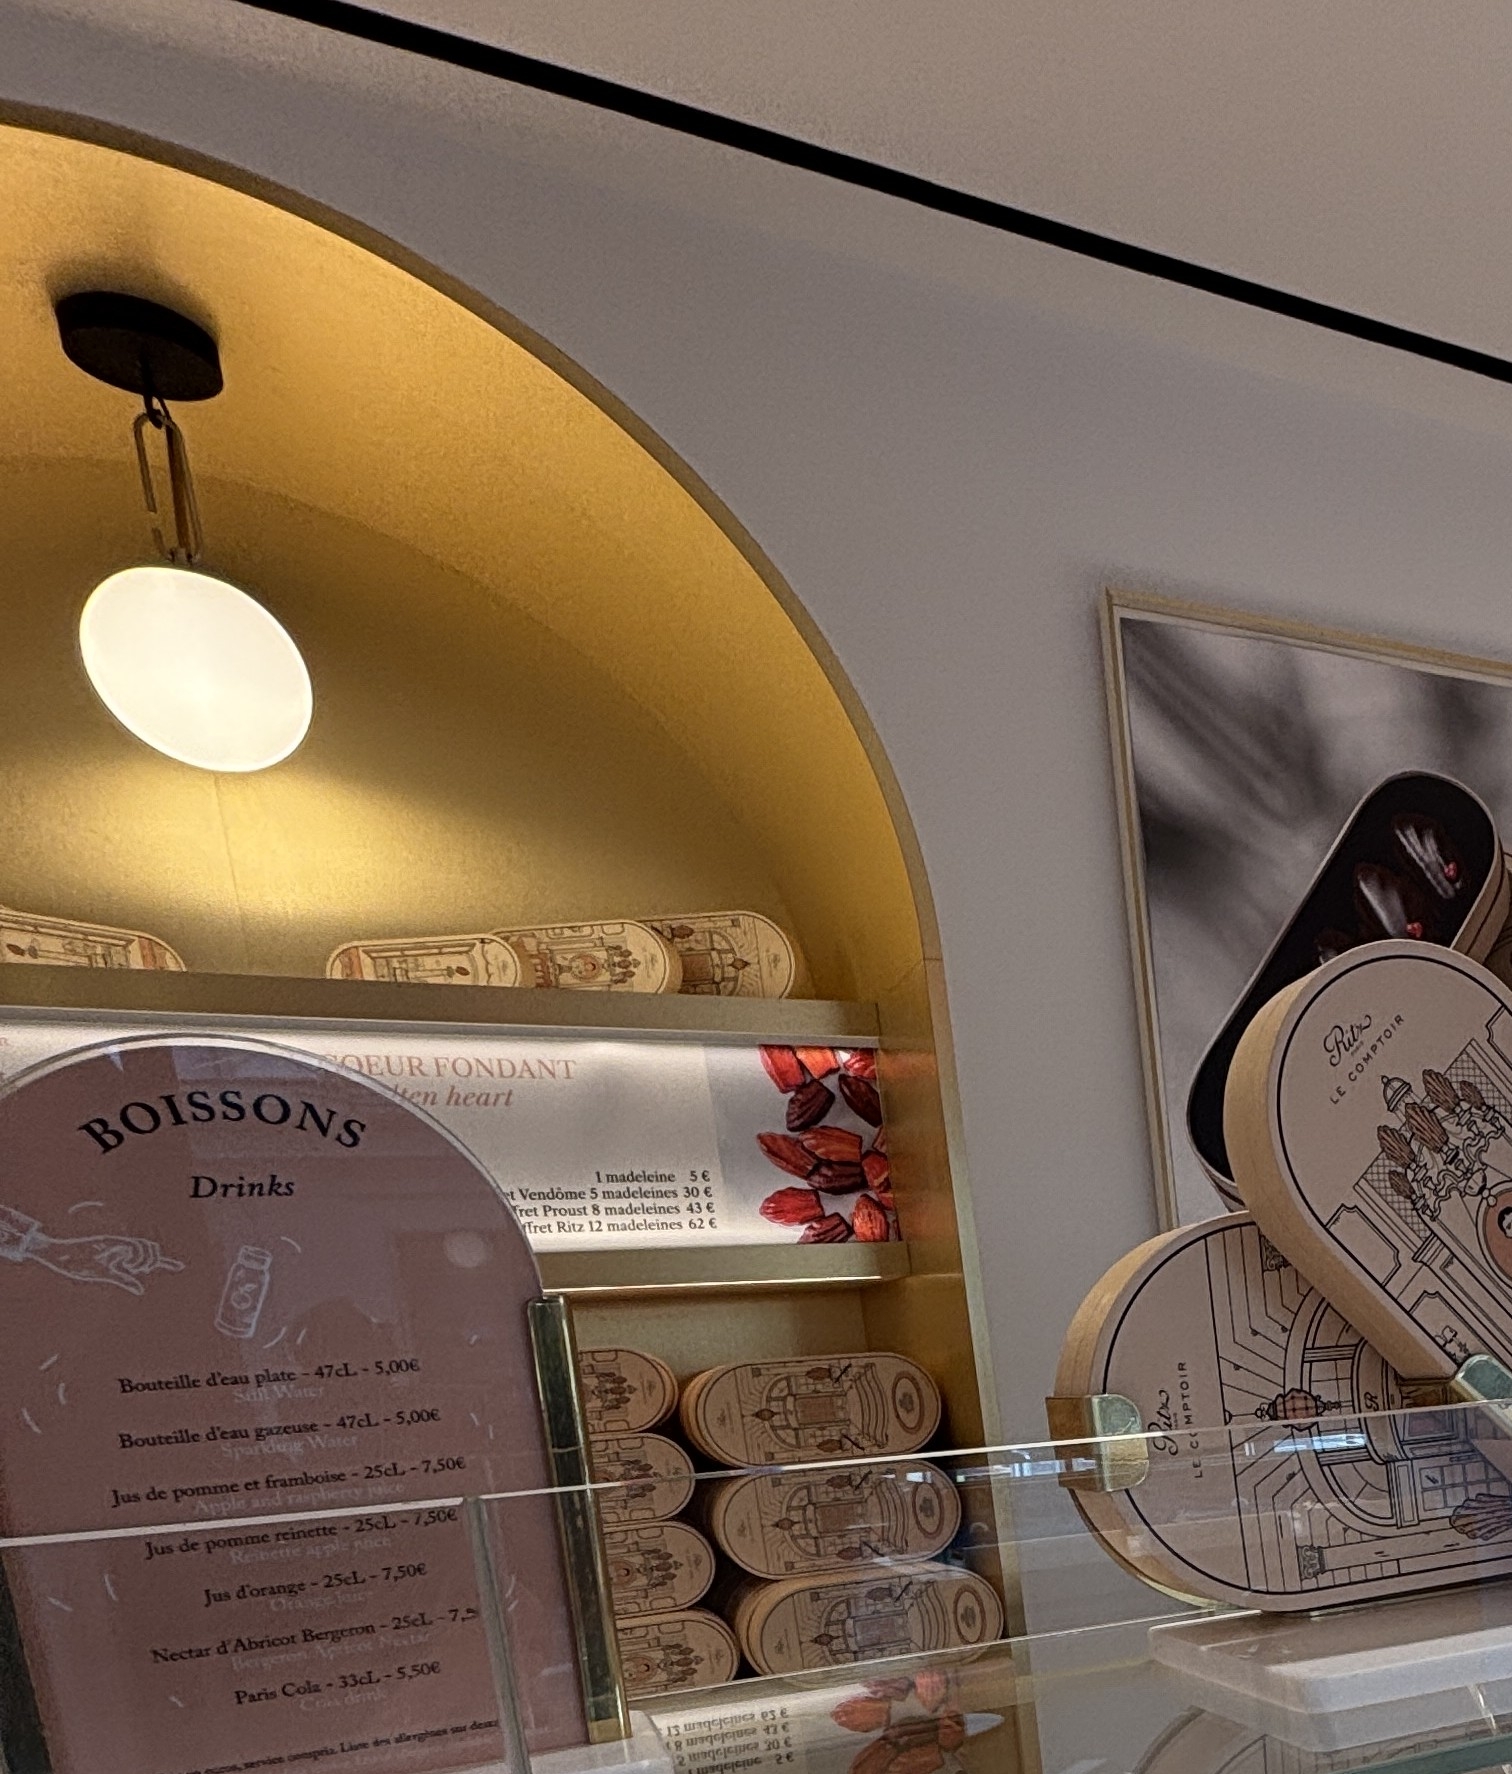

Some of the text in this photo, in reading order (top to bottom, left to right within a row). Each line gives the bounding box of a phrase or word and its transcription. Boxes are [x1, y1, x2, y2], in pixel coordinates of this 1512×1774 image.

[1323, 1014, 1372, 1067] Ritz
[1329, 1085, 1346, 1105] LE
[1348, 1014, 1405, 1082] COMPTOIR
[325, 1054, 577, 1079] OEUR FONDANT
[445, 1085, 513, 1107] heart
[77, 1090, 367, 1154] BOISSONS
[189, 1174, 295, 1199] Drinks
[518, 1187, 587, 1201] Vendôme
[590, 1187, 598, 1200] 5
[602, 1186, 678, 1200] madeleines
[683, 1186, 700, 1199] 30
[703, 1186, 713, 1198] €
[606, 1170, 676, 1183] madeleine
[689, 1170, 698, 1182] 5
[701, 1170, 711, 1182] €
[542, 1203, 588, 1217] Proust
[591, 1204, 600, 1217] 8
[604, 1203, 681, 1216] madeleines
[685, 1203, 702, 1214] 43
[705, 1202, 715, 1213] €
[556, 1220, 585, 1233] Ritz
[589, 1219, 602, 1232] 12
[606, 1219, 683, 1232] madeleines
[688, 1218, 705, 1230] 62
[708, 1218, 718, 1229] €
[117, 1374, 201, 1394] Bouteille
[205, 1371, 250, 1387] d'eau
[254, 1368, 297, 1388] plate
[314, 1362, 358, 1379] 47cL
[374, 1358, 421, 1376] 5,00€
[118, 1429, 201, 1449] Bouteille
[205, 1426, 250, 1442] d'eau
[254, 1421, 319, 1442] gazeuse
[336, 1413, 380, 1429] 47cL
[396, 1408, 441, 1425] 5,00€
[111, 1489, 141, 1508] Jus
[146, 1486, 168, 1501] de
[172, 1482, 240, 1503] pomme
[244, 1480, 260, 1492] et
[265, 1470, 346, 1489] framboise
[364, 1462, 406, 1480] 25cL
[422, 1456, 467, 1475] 7,50€
[144, 1541, 174, 1561] Jus
[178, 1538, 200, 1553] de
[205, 1533, 271, 1554] pomme
[274, 1524, 338, 1542] reinette
[355, 1515, 396, 1533] 25cL
[414, 1508, 458, 1527] 7,50€
[204, 1588, 231, 1608] Jus
[235, 1581, 306, 1600] d'orange
[323, 1571, 366, 1588] 25cL
[381, 1563, 428, 1582] 7,50€
[152, 1648, 211, 1663] Nectar
[301, 1623, 376, 1644] Bergeron
[391, 1612, 433, 1630] 25cL
[234, 1687, 277, 1705] Paris
[281, 1680, 322, 1697] Cola
[338, 1671, 381, 1689] 33cL
[396, 1661, 441, 1681] 5,50€
